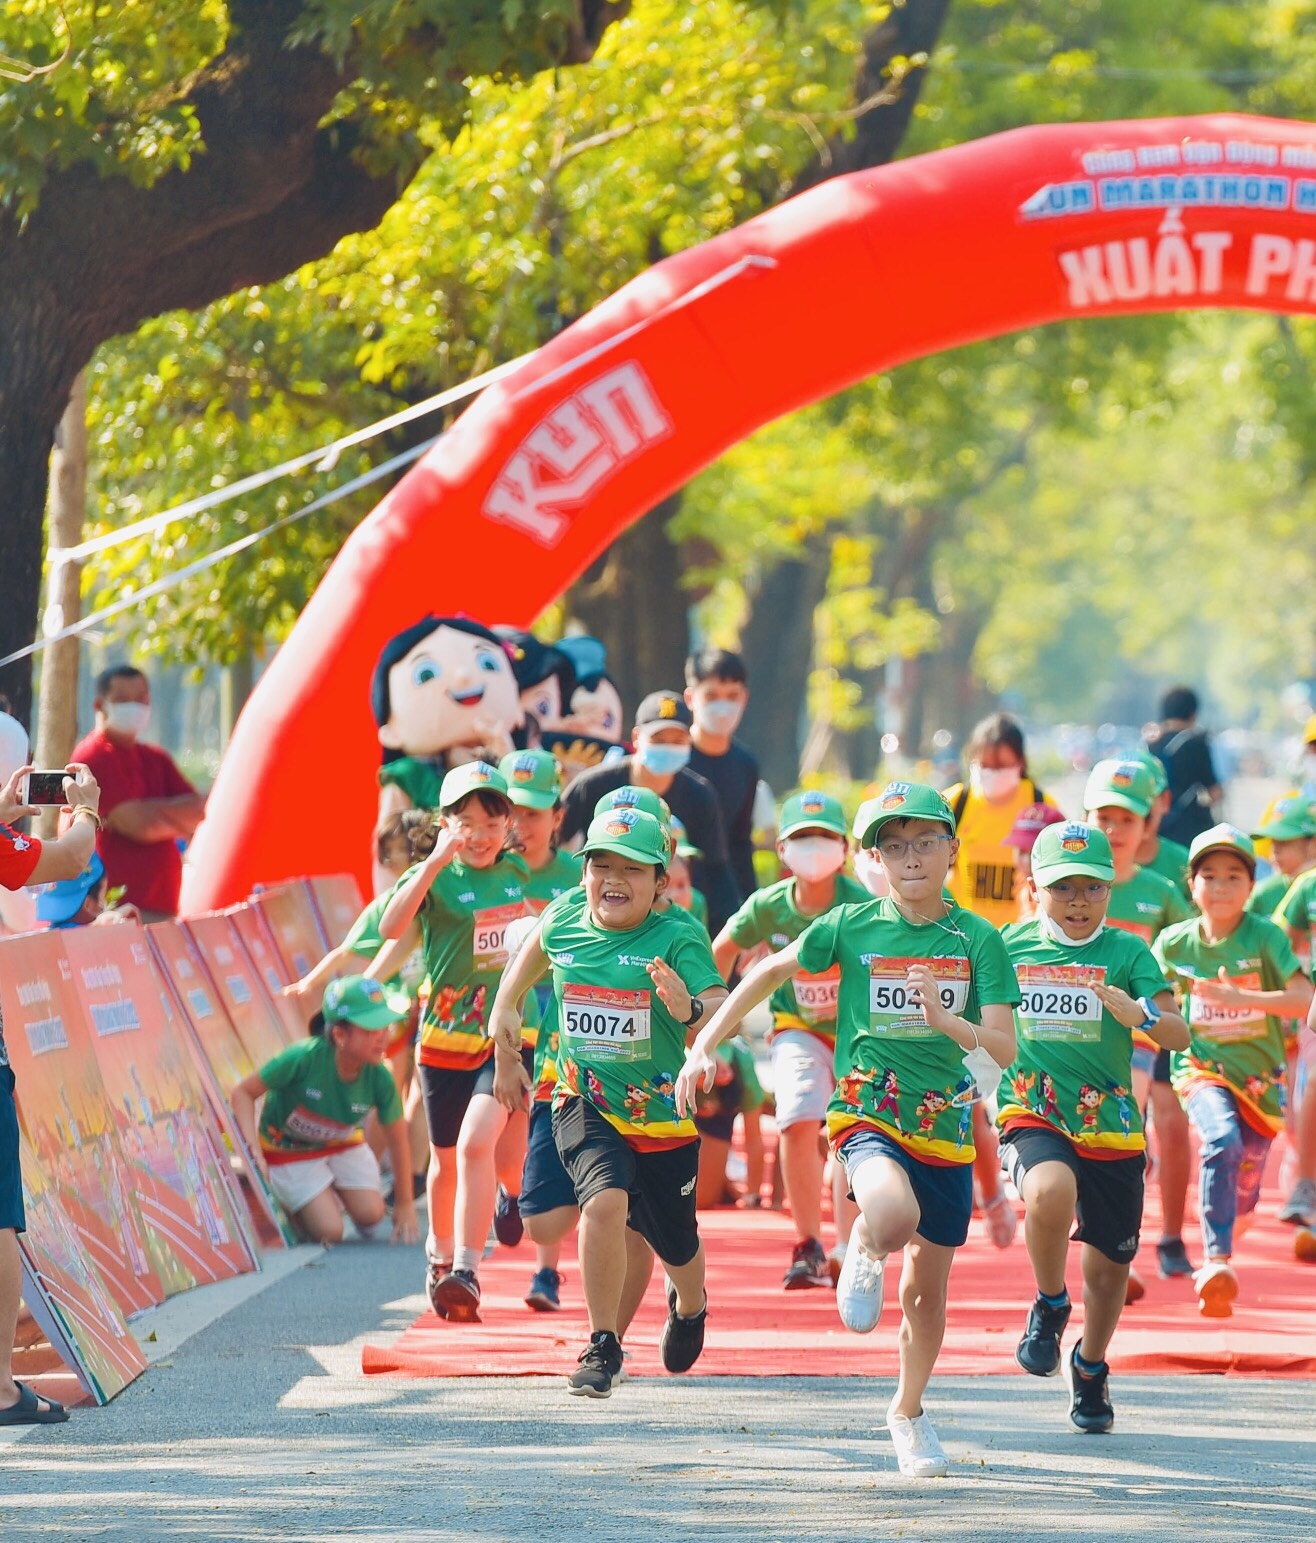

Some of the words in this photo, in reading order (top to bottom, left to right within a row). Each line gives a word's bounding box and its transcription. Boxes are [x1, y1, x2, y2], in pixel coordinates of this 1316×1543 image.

[1103, 178, 1287, 207] MARATHON
[1059, 205, 1232, 307] XUẤT
[876, 986, 955, 1010] 5049
[1020, 992, 1088, 1015] 50286
[567, 1011, 636, 1037] 50074
